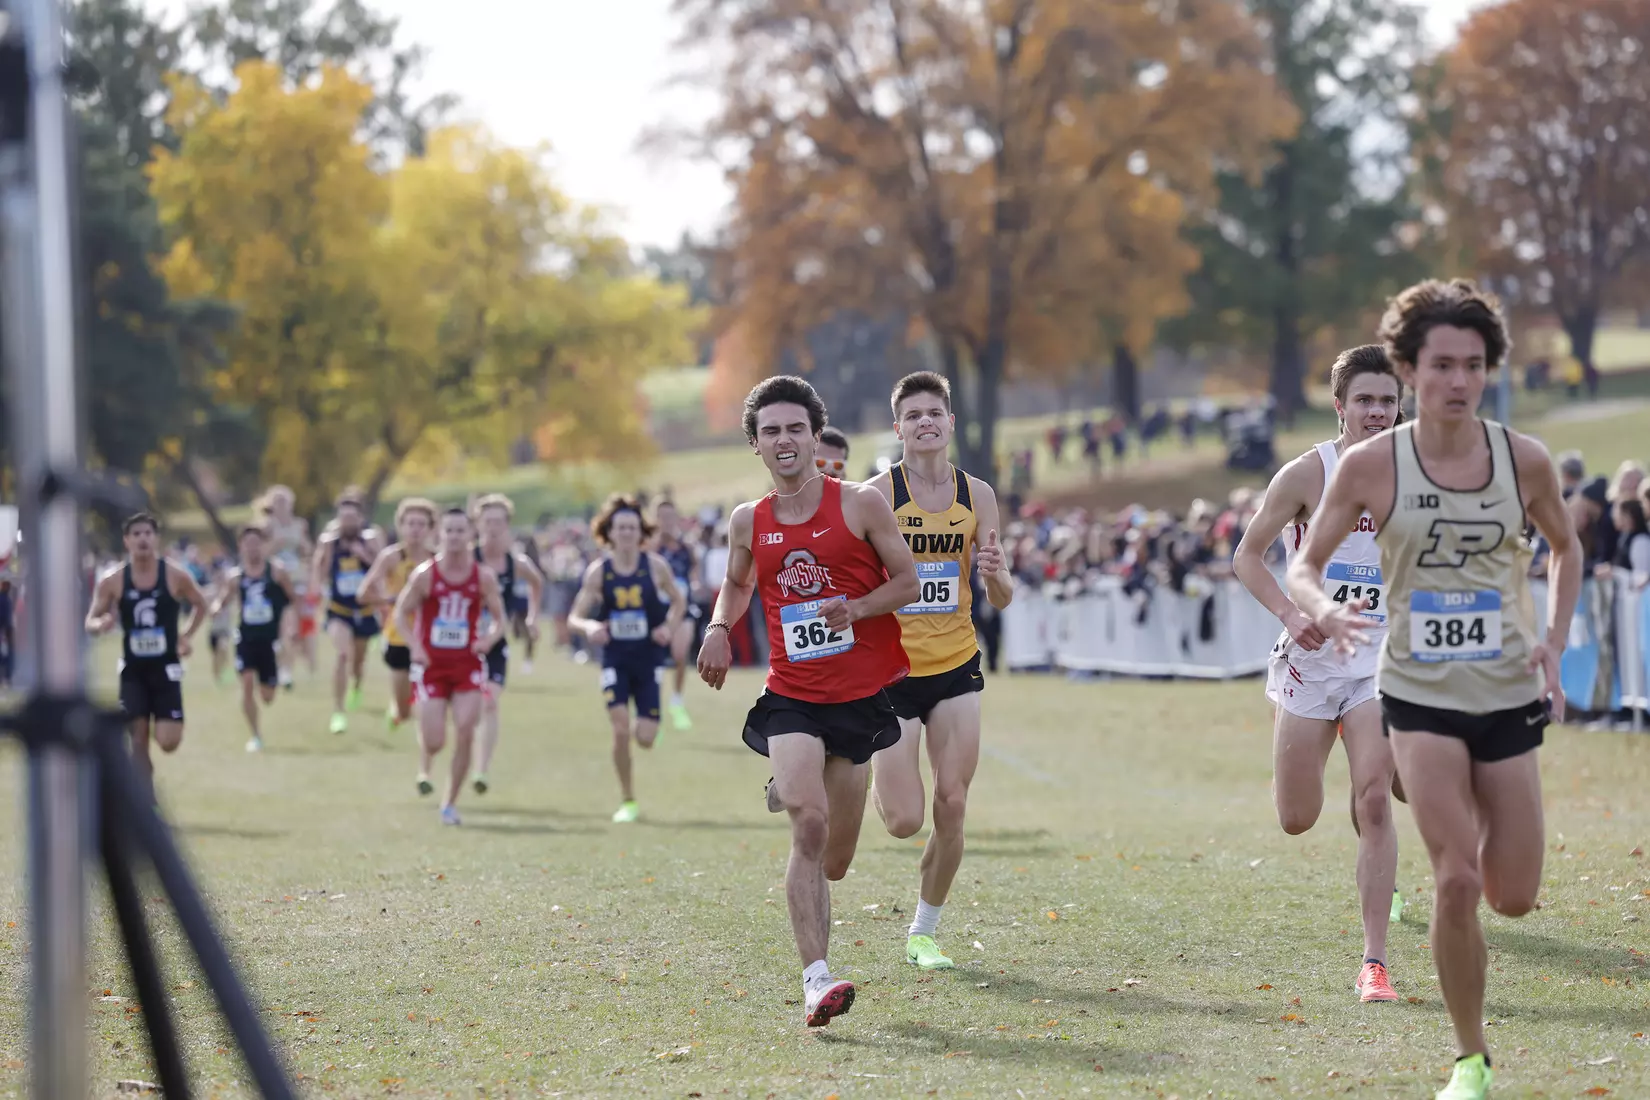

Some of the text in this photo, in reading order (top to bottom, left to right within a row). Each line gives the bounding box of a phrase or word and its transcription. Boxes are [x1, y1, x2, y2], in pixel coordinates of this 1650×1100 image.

[1416, 519, 1505, 568] P
[916, 581, 950, 603] 05
[1332, 585, 1380, 610] 413
[792, 621, 842, 649] 362
[1425, 617, 1486, 648] 384
